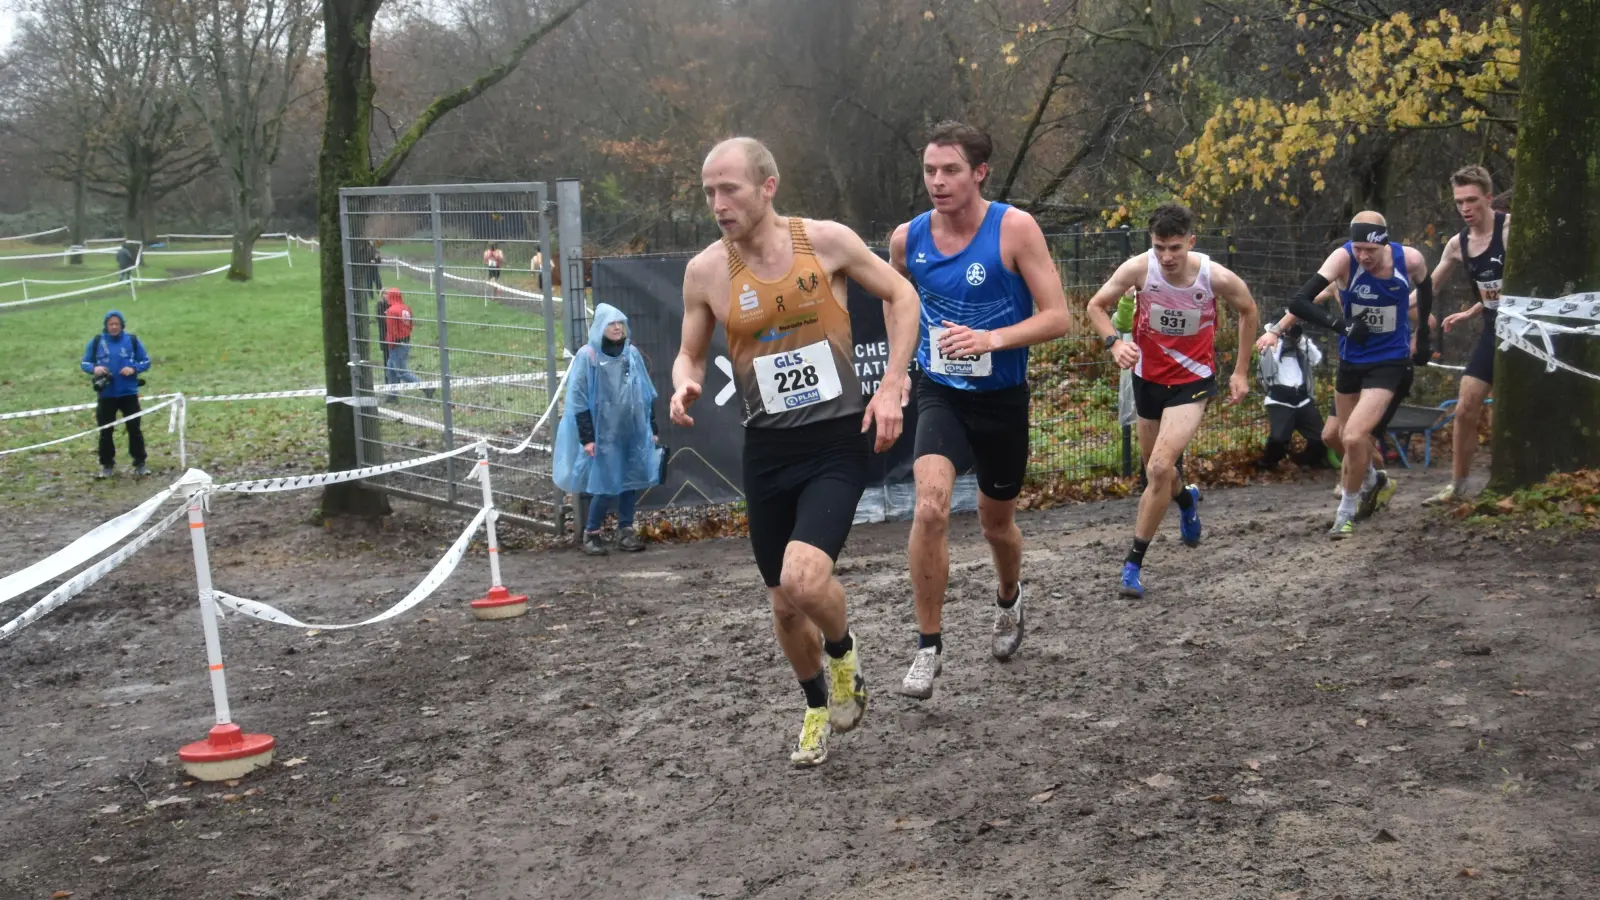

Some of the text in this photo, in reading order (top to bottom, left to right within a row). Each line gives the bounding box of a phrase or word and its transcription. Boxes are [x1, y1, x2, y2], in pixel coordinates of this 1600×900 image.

[1164, 309, 1183, 317] GLS
[1160, 315, 1187, 328] 931
[774, 352, 804, 369] GLS
[773, 365, 819, 394] 228
[797, 390, 819, 401] PLAN
